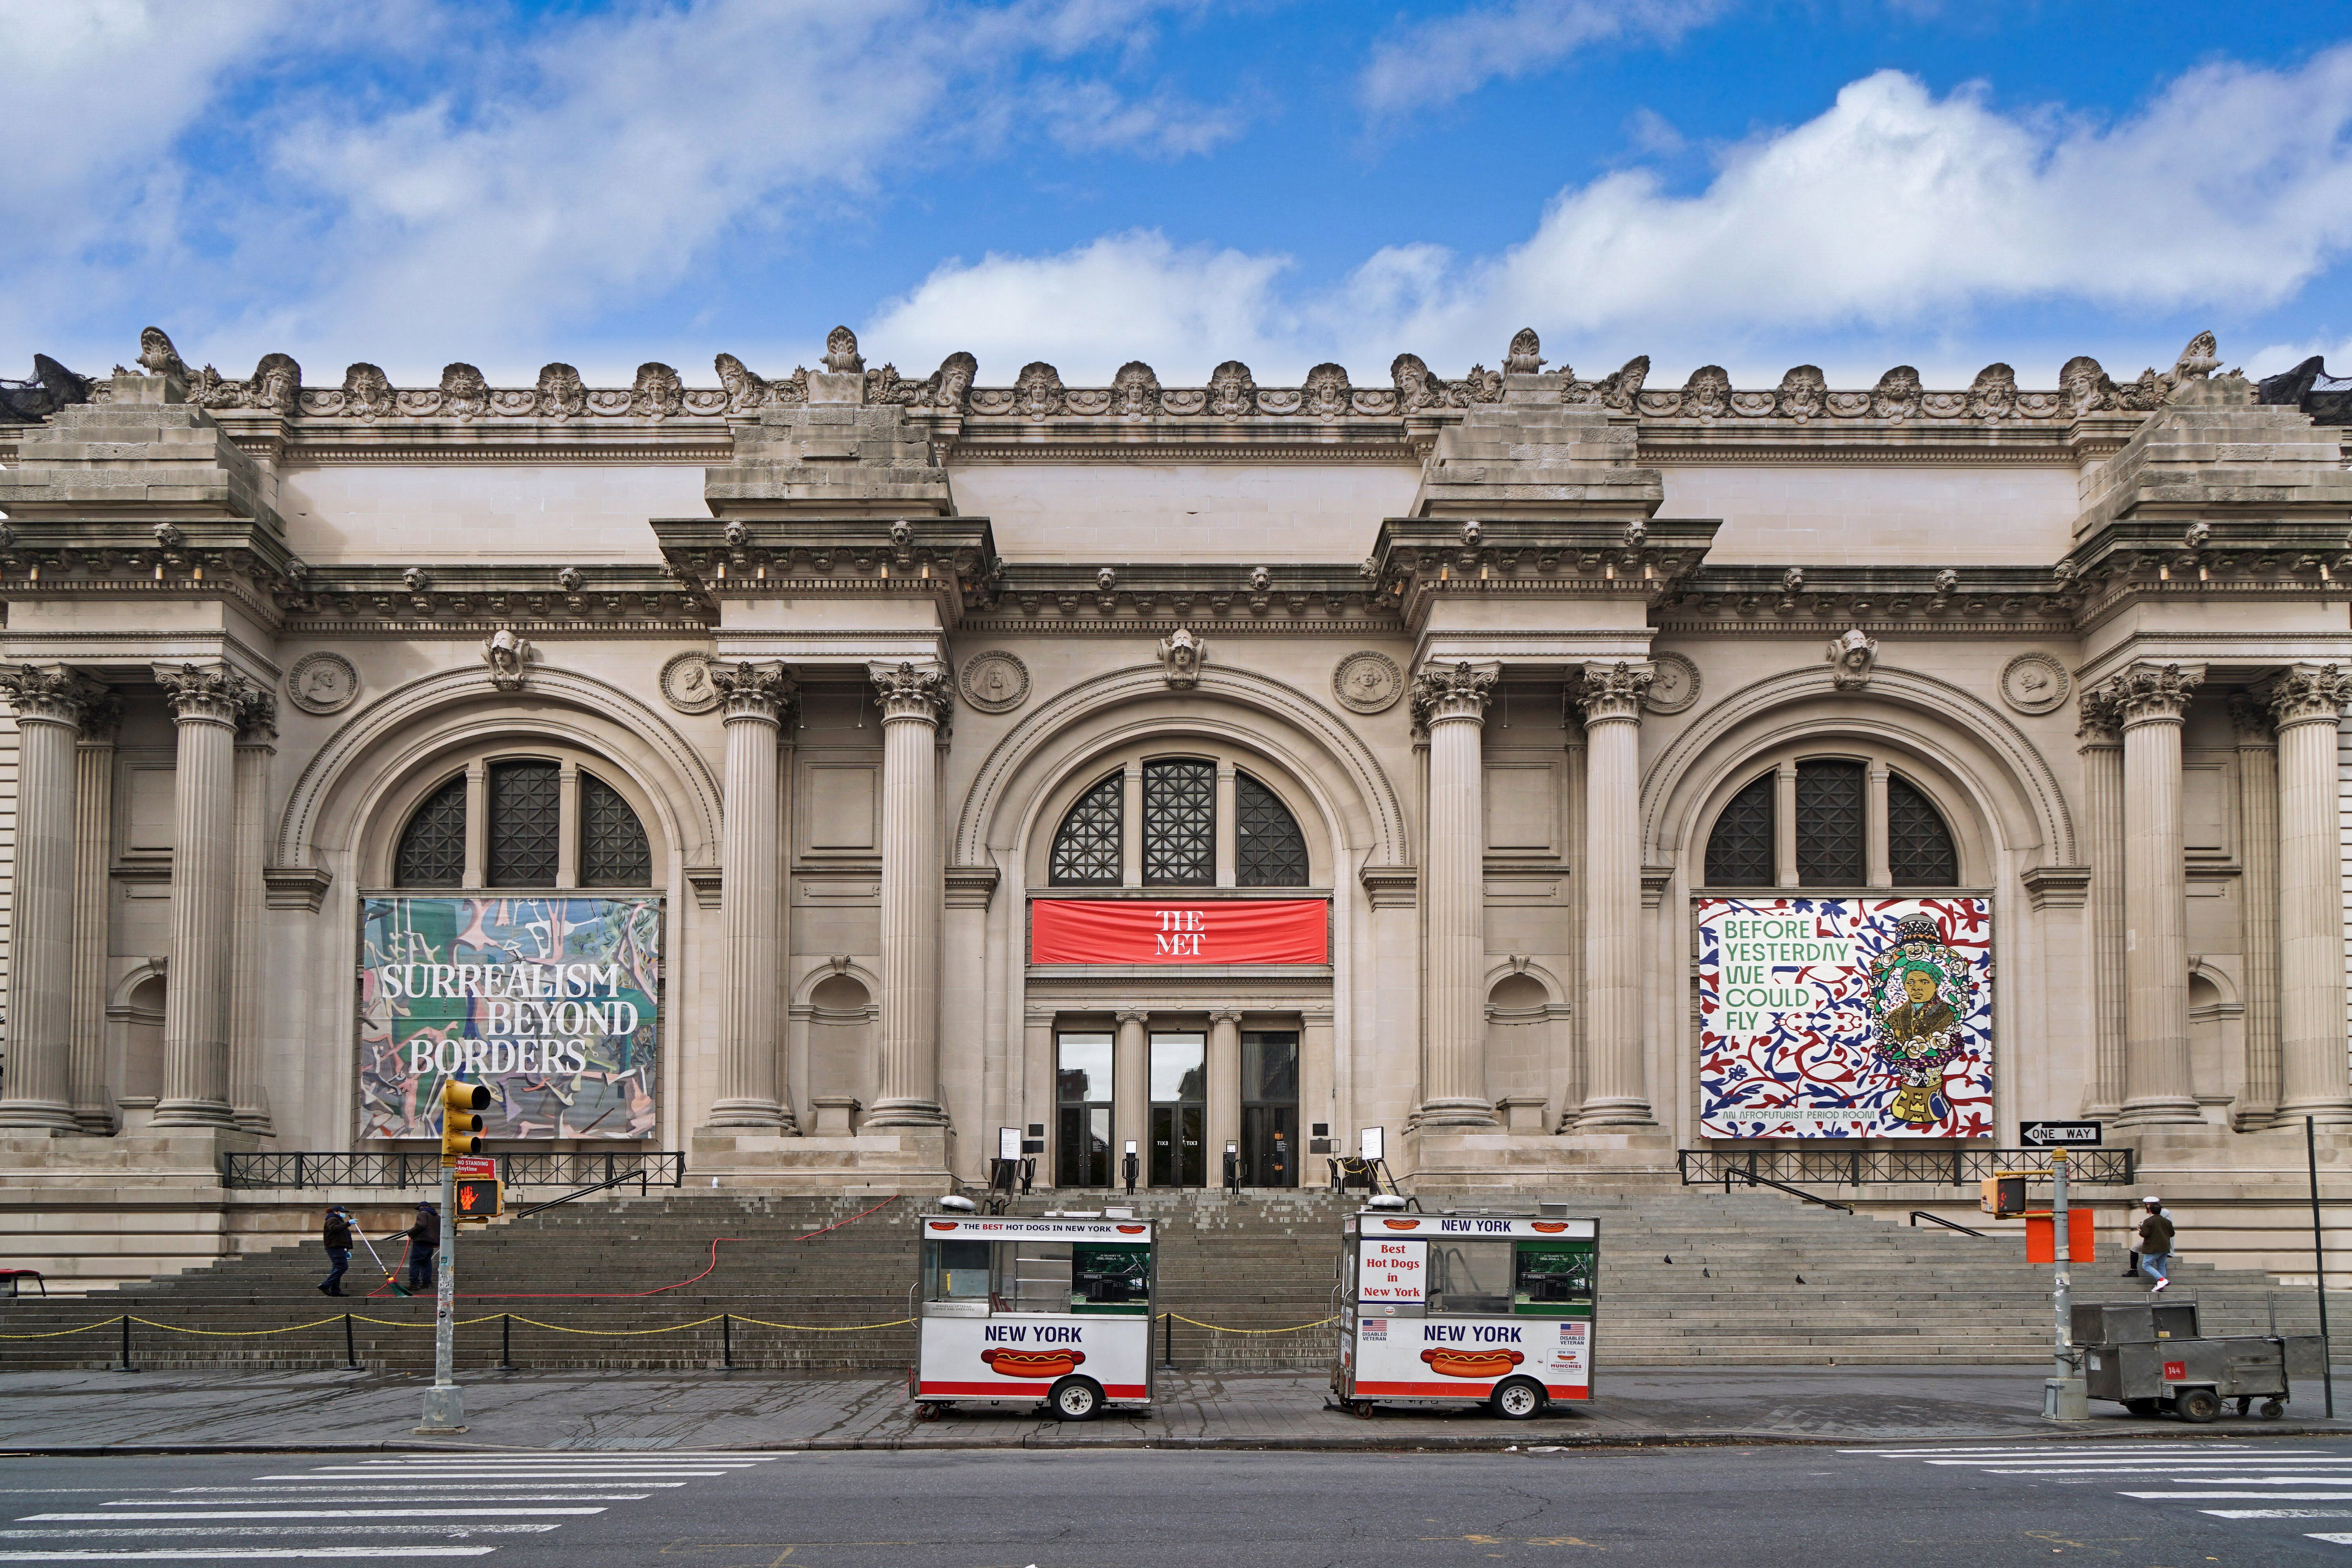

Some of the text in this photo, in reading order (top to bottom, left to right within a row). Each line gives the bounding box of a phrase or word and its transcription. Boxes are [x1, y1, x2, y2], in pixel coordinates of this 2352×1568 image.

[1155, 911, 1205, 931] THE
[1725, 920, 1810, 938] BEFORE
[1154, 934, 1206, 955] MET
[1725, 943, 1849, 961] YESTERDAY
[382, 964, 620, 998] SURREALISM
[1726, 965, 1764, 984] WE
[1726, 988, 1809, 1007] COULD
[486, 1001, 639, 1035] BEYOND
[1726, 1011, 1759, 1030] FLY
[408, 1039, 586, 1074] BORDERS
[2033, 1129, 2091, 1139] ONE WAY
[1442, 1220, 1512, 1232] NEW YORK
[1381, 1245, 1406, 1254] Best
[1367, 1259, 1419, 1270] Hot Dogs
[1387, 1273, 1398, 1282] in
[1364, 1287, 1420, 1297] New York
[985, 1325, 1082, 1342] NEW YORK
[1424, 1325, 1522, 1342] NEW YORK
